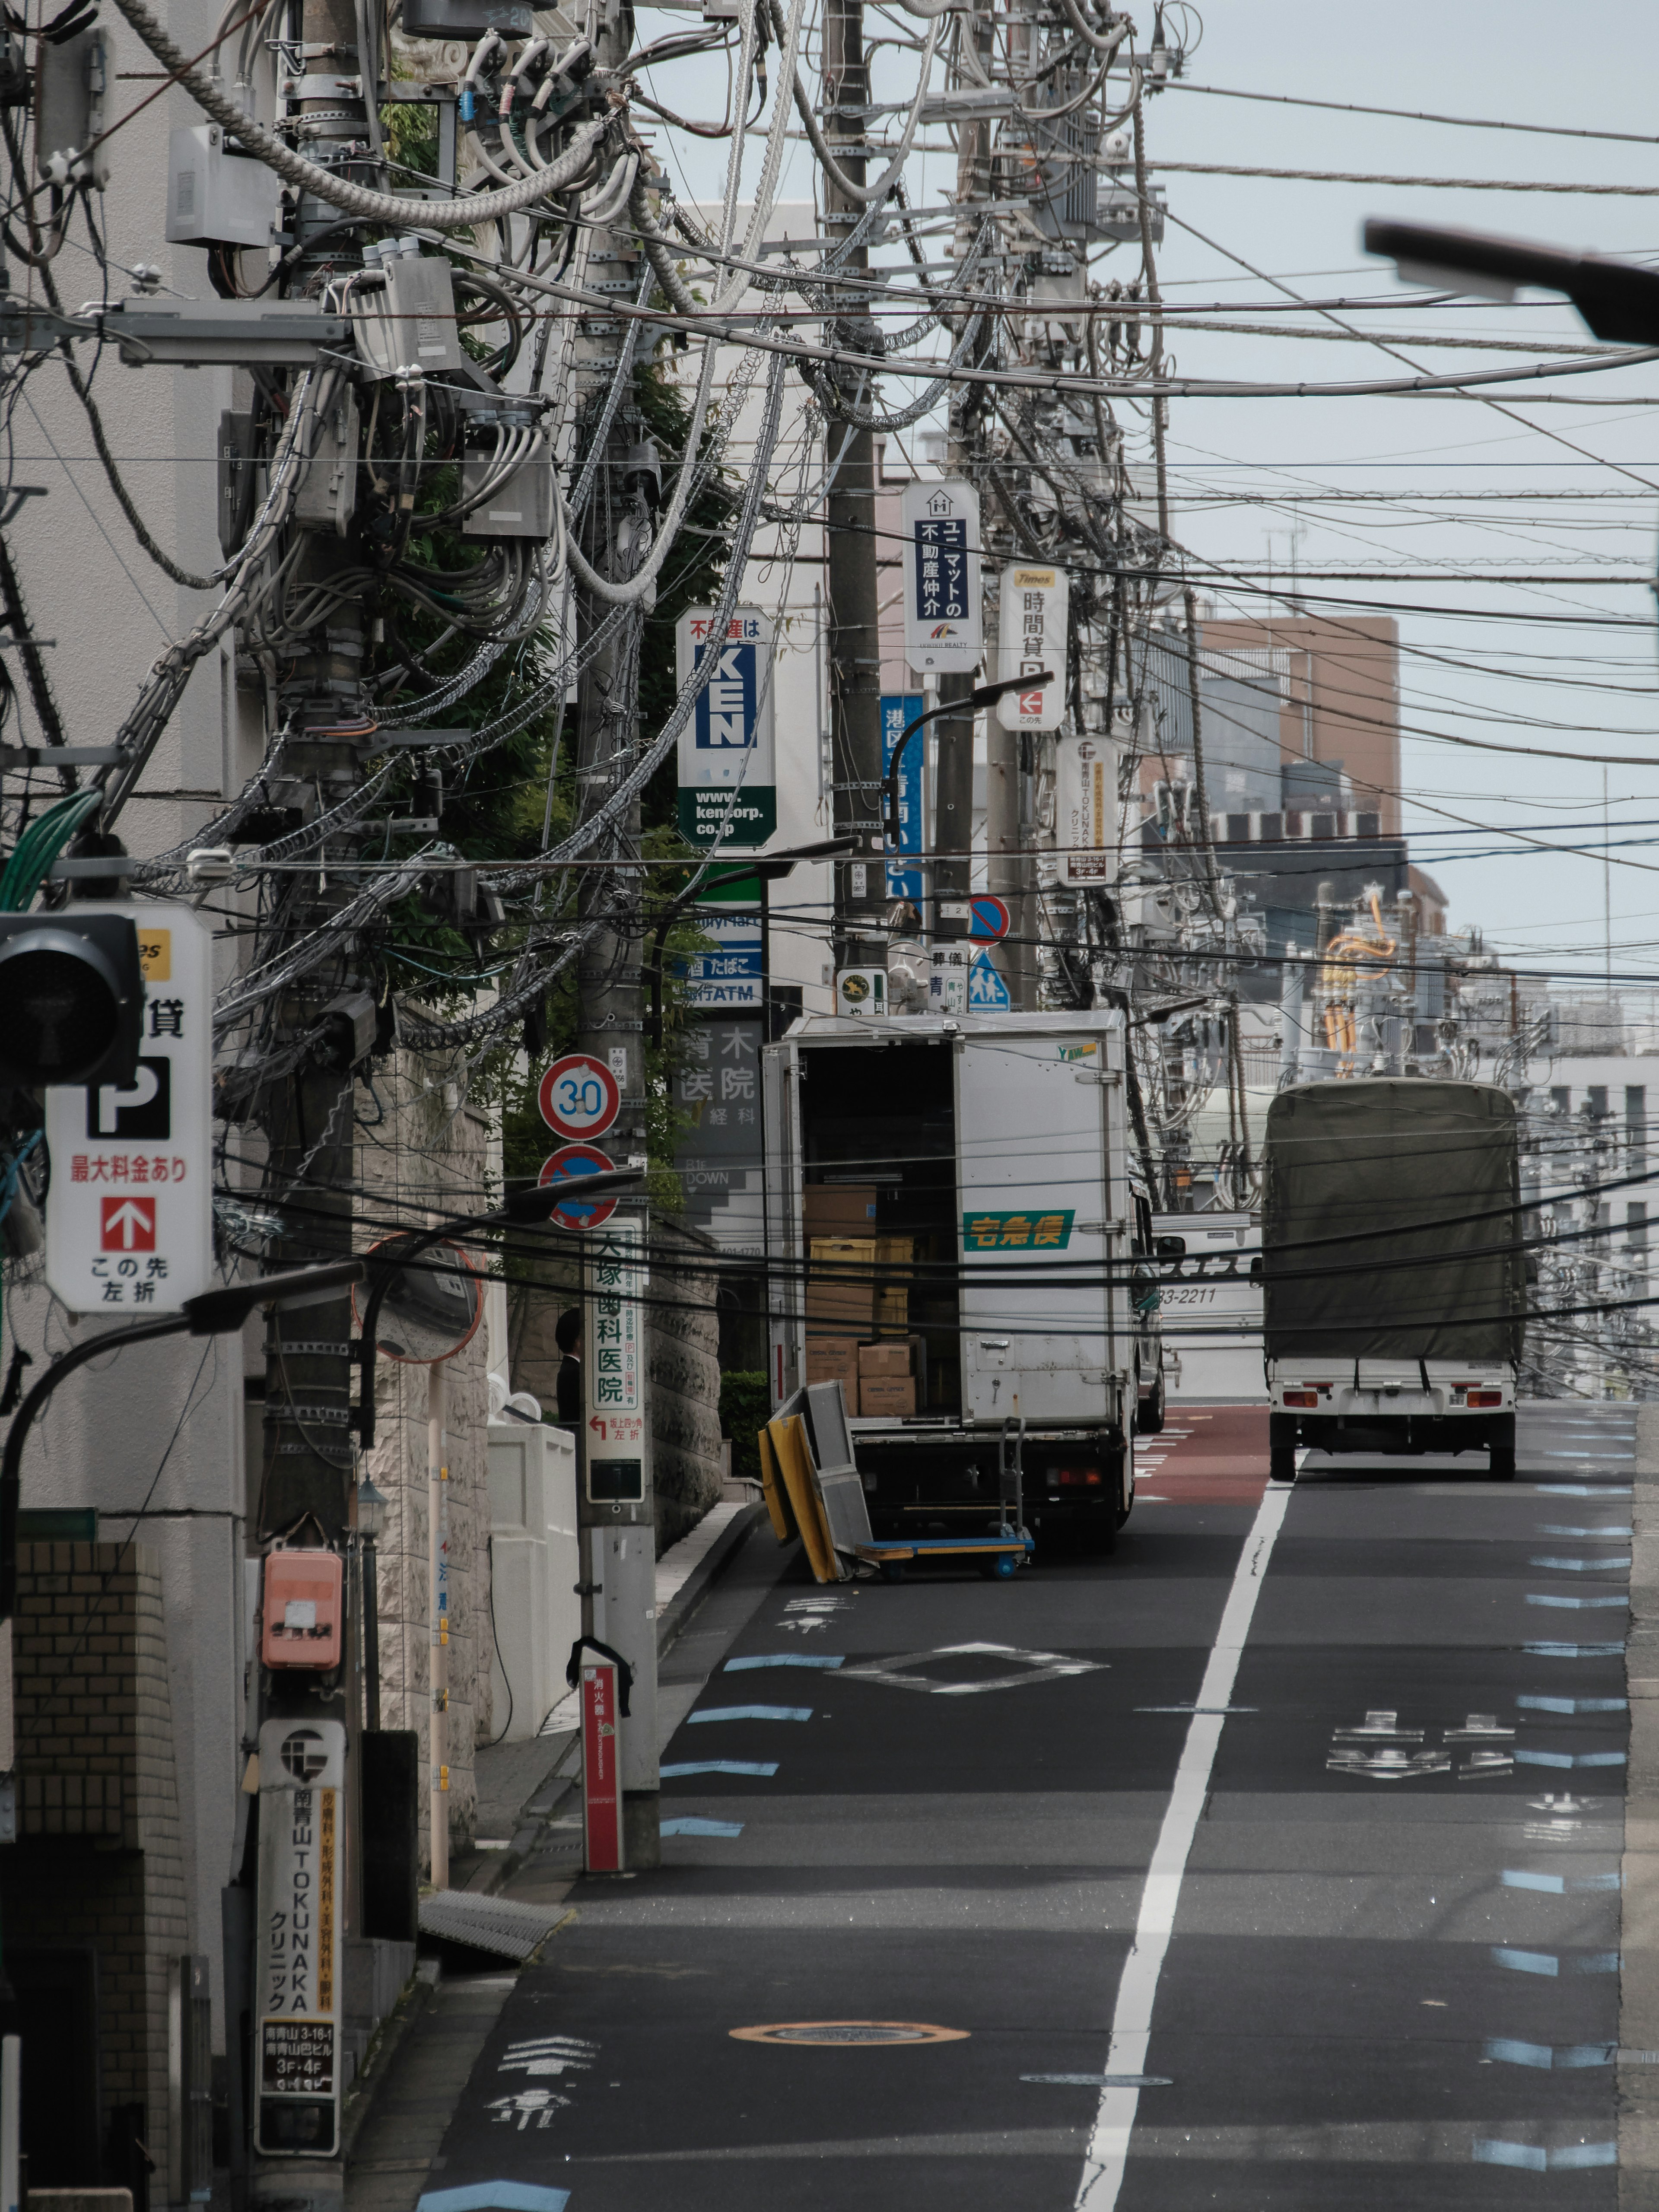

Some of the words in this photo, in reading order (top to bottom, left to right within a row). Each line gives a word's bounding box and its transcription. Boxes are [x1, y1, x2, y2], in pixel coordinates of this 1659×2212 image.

[922, 524, 941, 617] 不動産仲介
[943, 522, 962, 617] ユニマットの
[1018, 574, 1051, 585] Times
[690, 619, 760, 640] 不産は
[1022, 592, 1045, 658] 時間貸
[709, 648, 744, 745] KEN
[696, 793, 742, 803] www.
[711, 957, 749, 975] たばこ
[932, 952, 963, 967] 葬儀
[681, 1067, 755, 1101] 医院
[559, 1080, 601, 1116] 30
[70, 1155, 186, 1184] 最大料金あり
[686, 1172, 729, 1185] DOWN
[970, 1215, 1065, 1246] 宅急便
[91, 1257, 168, 1280] この先
[102, 1280, 155, 1303] 左折
[596, 1231, 623, 1403] 大塚歯科医院
[614, 1430, 639, 1440] 左折
[594, 1679, 604, 1716] 消火器
[269, 1911, 287, 2013] クリニック
[266, 2026, 298, 2040] 南青山
[301, 2027, 332, 2041] 3-16-1
[266, 2042, 332, 2056] 南青山巴ビル
